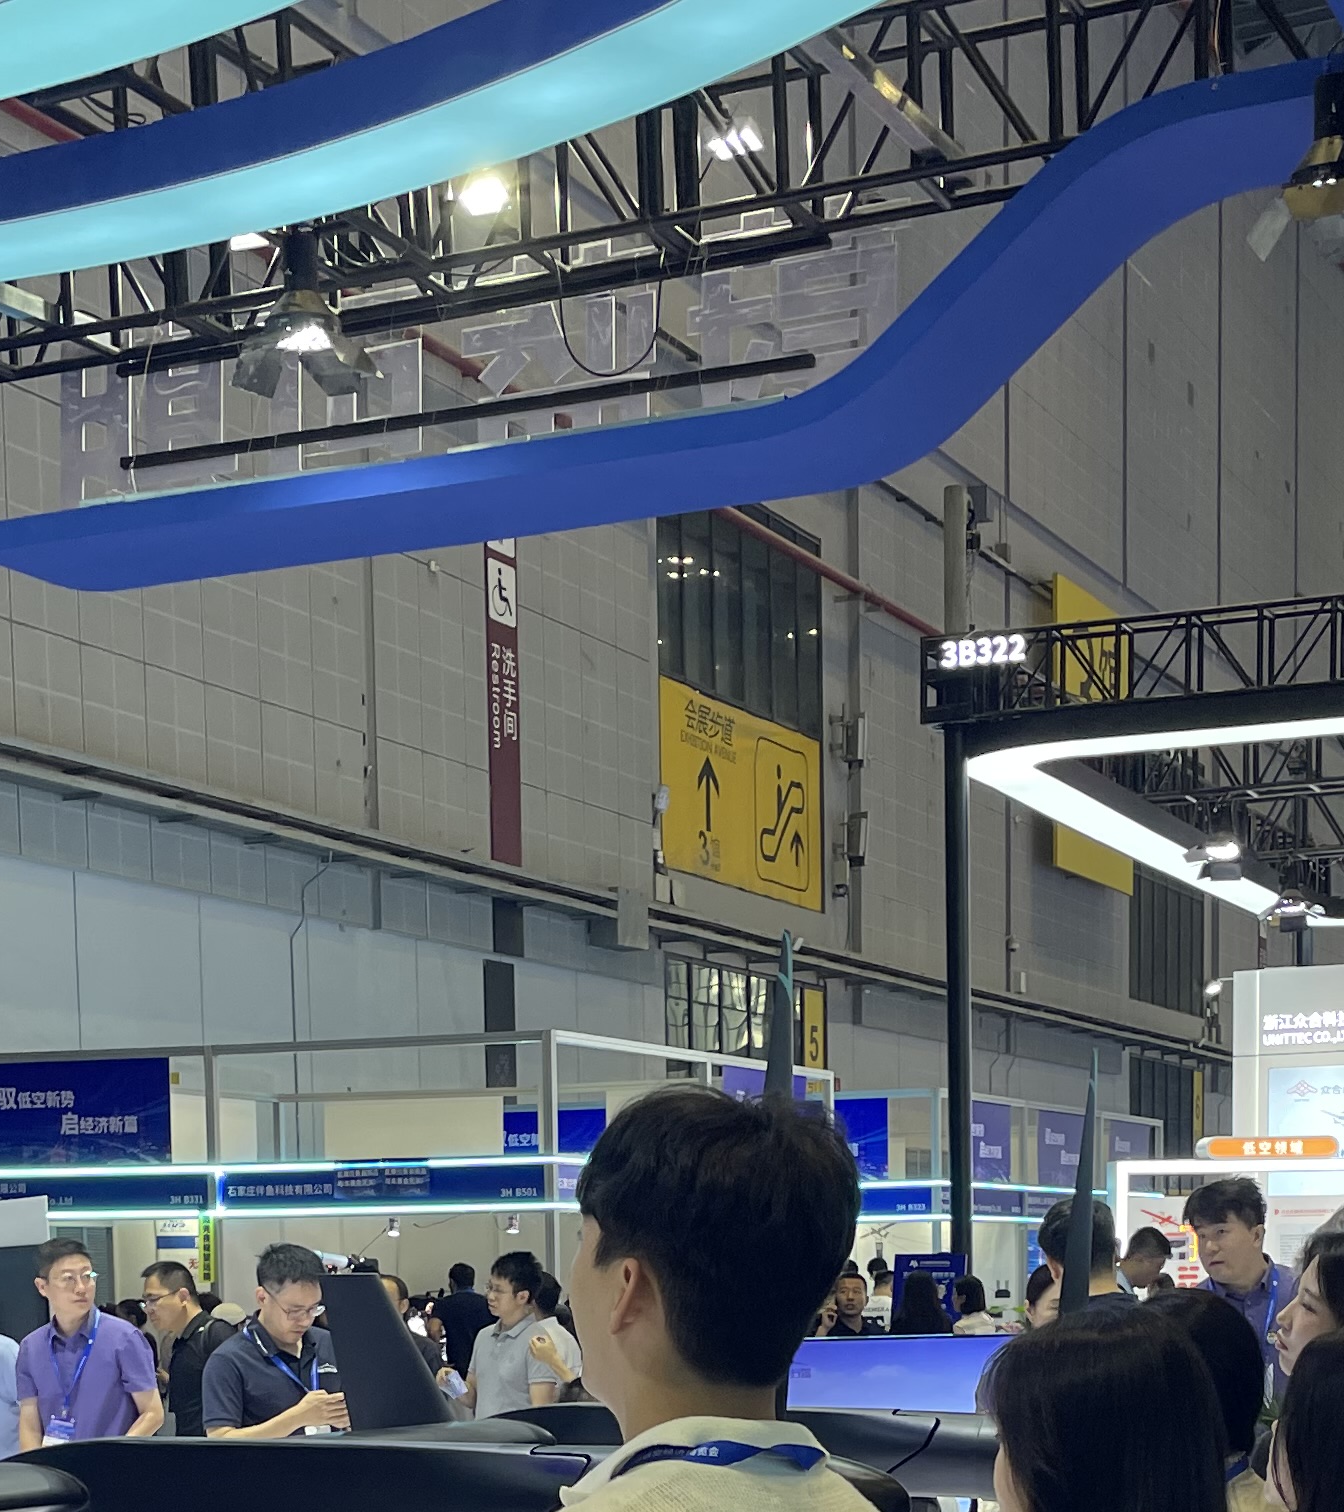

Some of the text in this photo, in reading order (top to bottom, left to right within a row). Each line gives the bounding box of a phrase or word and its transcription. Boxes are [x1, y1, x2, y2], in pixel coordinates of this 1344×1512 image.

[940, 633, 1026, 669] 3B322
[491, 642, 501, 749] Restroom
[501, 646, 518, 741] 洗手间
[684, 699, 735, 746] 会展步道
[810, 1026, 819, 1062] 5
[60, 1112, 138, 1136] 启经济新篇
[1242, 1140, 1304, 1156] 低空领域
[515, 1187, 538, 1197] B501
